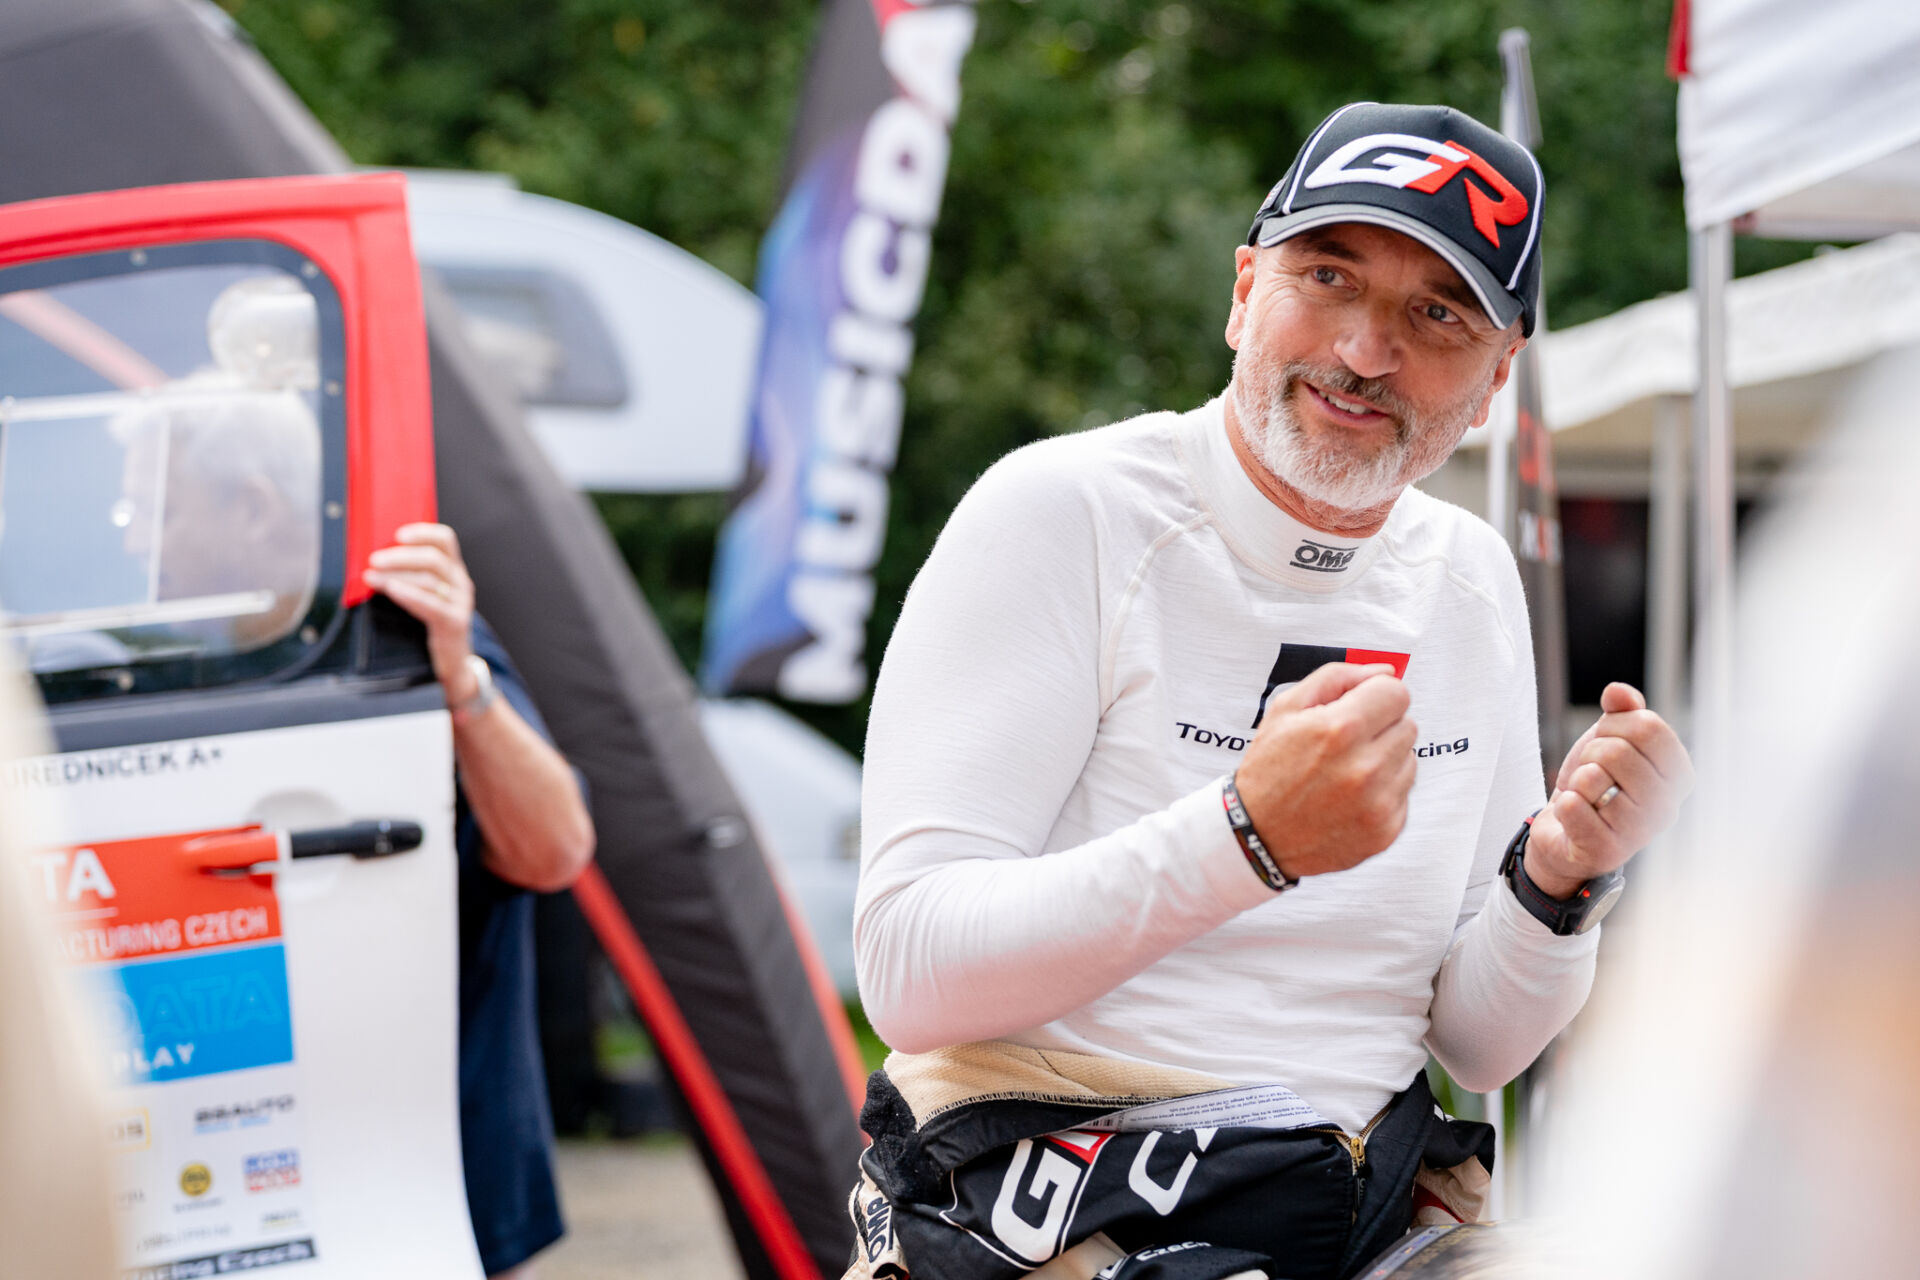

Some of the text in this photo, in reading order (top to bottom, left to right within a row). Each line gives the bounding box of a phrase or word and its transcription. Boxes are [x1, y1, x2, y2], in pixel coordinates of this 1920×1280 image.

[1303, 133, 1529, 249] GR
[1291, 542, 1358, 571] OMP
[1175, 722, 1469, 759] TOYO cing
[30, 848, 117, 901] TA
[54, 905, 269, 960] ACTURING CZECH
[866, 1196, 892, 1264] OMP
